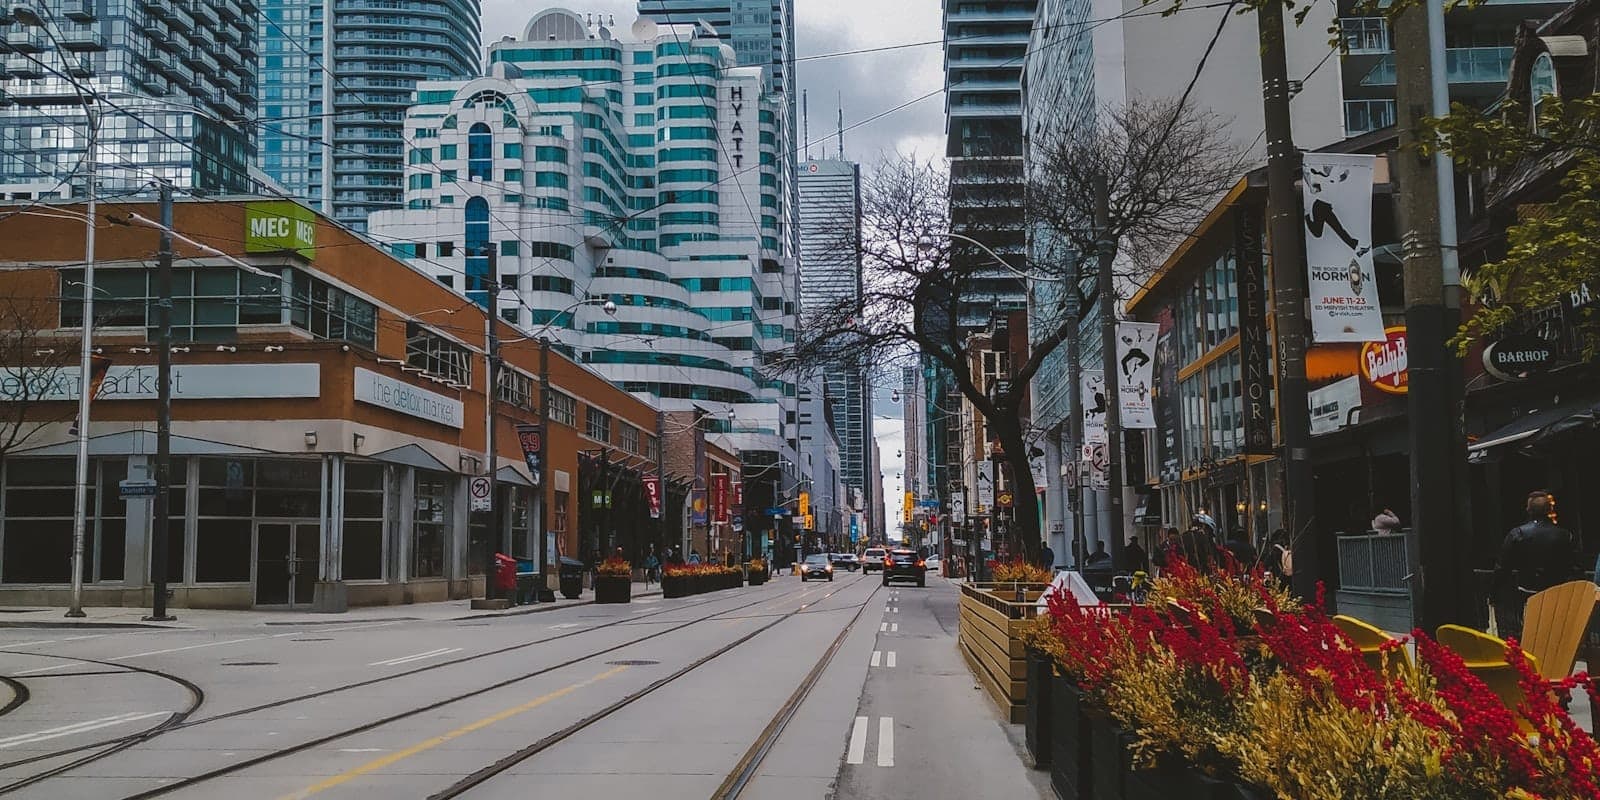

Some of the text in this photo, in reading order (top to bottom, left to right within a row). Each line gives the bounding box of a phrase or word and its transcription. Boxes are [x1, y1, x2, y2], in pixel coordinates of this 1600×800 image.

[731, 86, 744, 168] HYATT
[251, 217, 289, 237] MEC
[296, 220, 313, 245] MEC
[1346, 297, 1366, 305] 11-23
[1498, 350, 1549, 363] BARHOP
[1247, 326, 1264, 420] MANOR
[373, 376, 454, 424] the detox market
[520, 432, 540, 452] 99
[594, 495, 610, 504] MC
